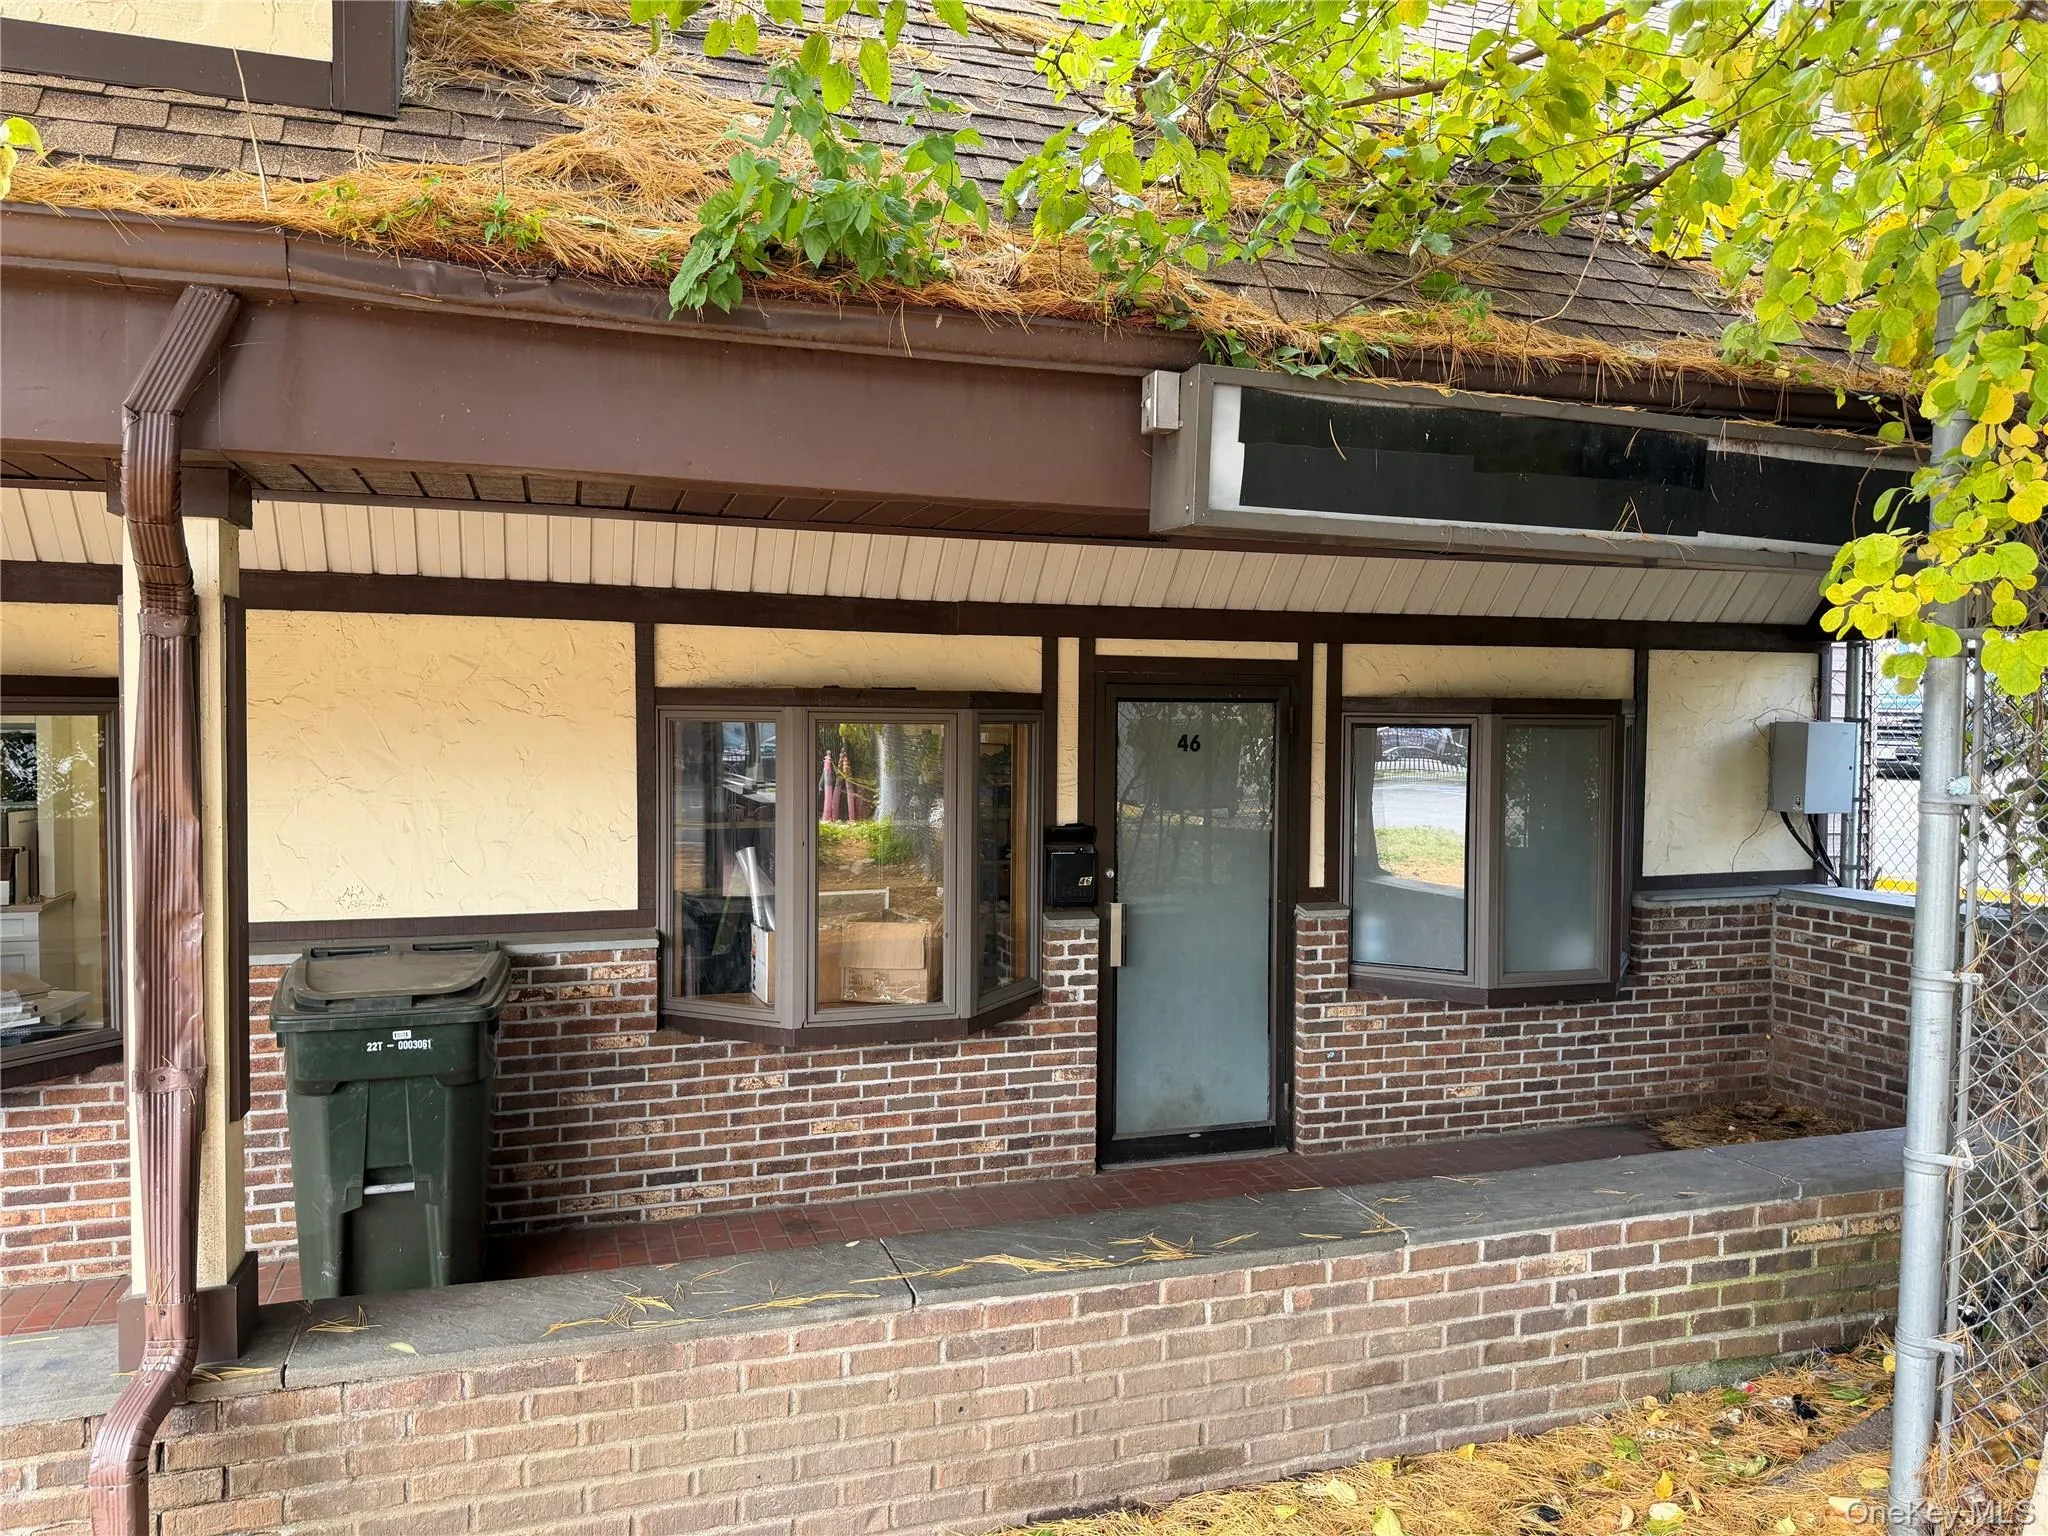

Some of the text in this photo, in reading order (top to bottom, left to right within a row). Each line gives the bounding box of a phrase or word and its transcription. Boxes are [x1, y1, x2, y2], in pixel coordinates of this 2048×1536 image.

[1177, 734, 1200, 752] 46
[1079, 877, 1092, 886] 46
[366, 1042, 383, 1052] 22T
